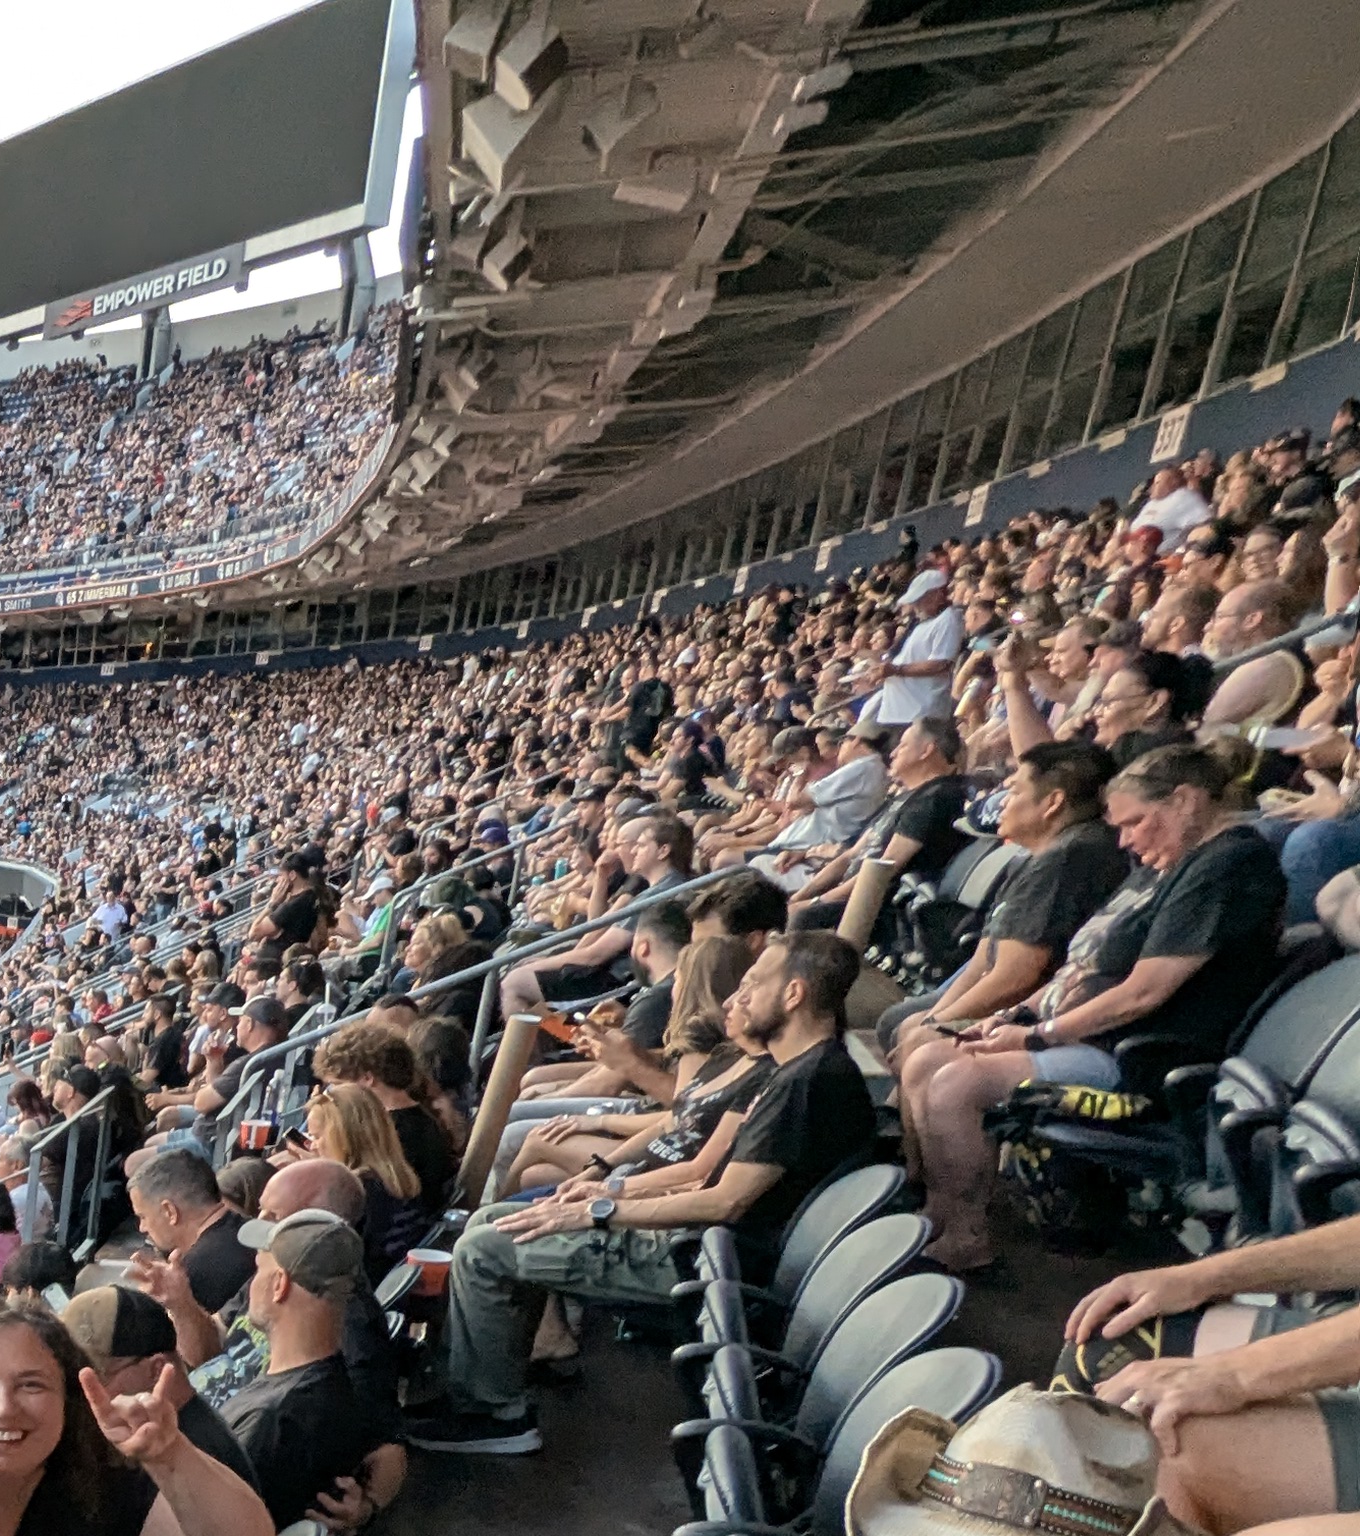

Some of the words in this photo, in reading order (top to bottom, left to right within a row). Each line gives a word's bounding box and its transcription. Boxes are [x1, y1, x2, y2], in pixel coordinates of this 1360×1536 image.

[93, 273, 174, 316] EMPOWER
[177, 257, 227, 292] FIELD
[4, 598, 32, 611] SMITH
